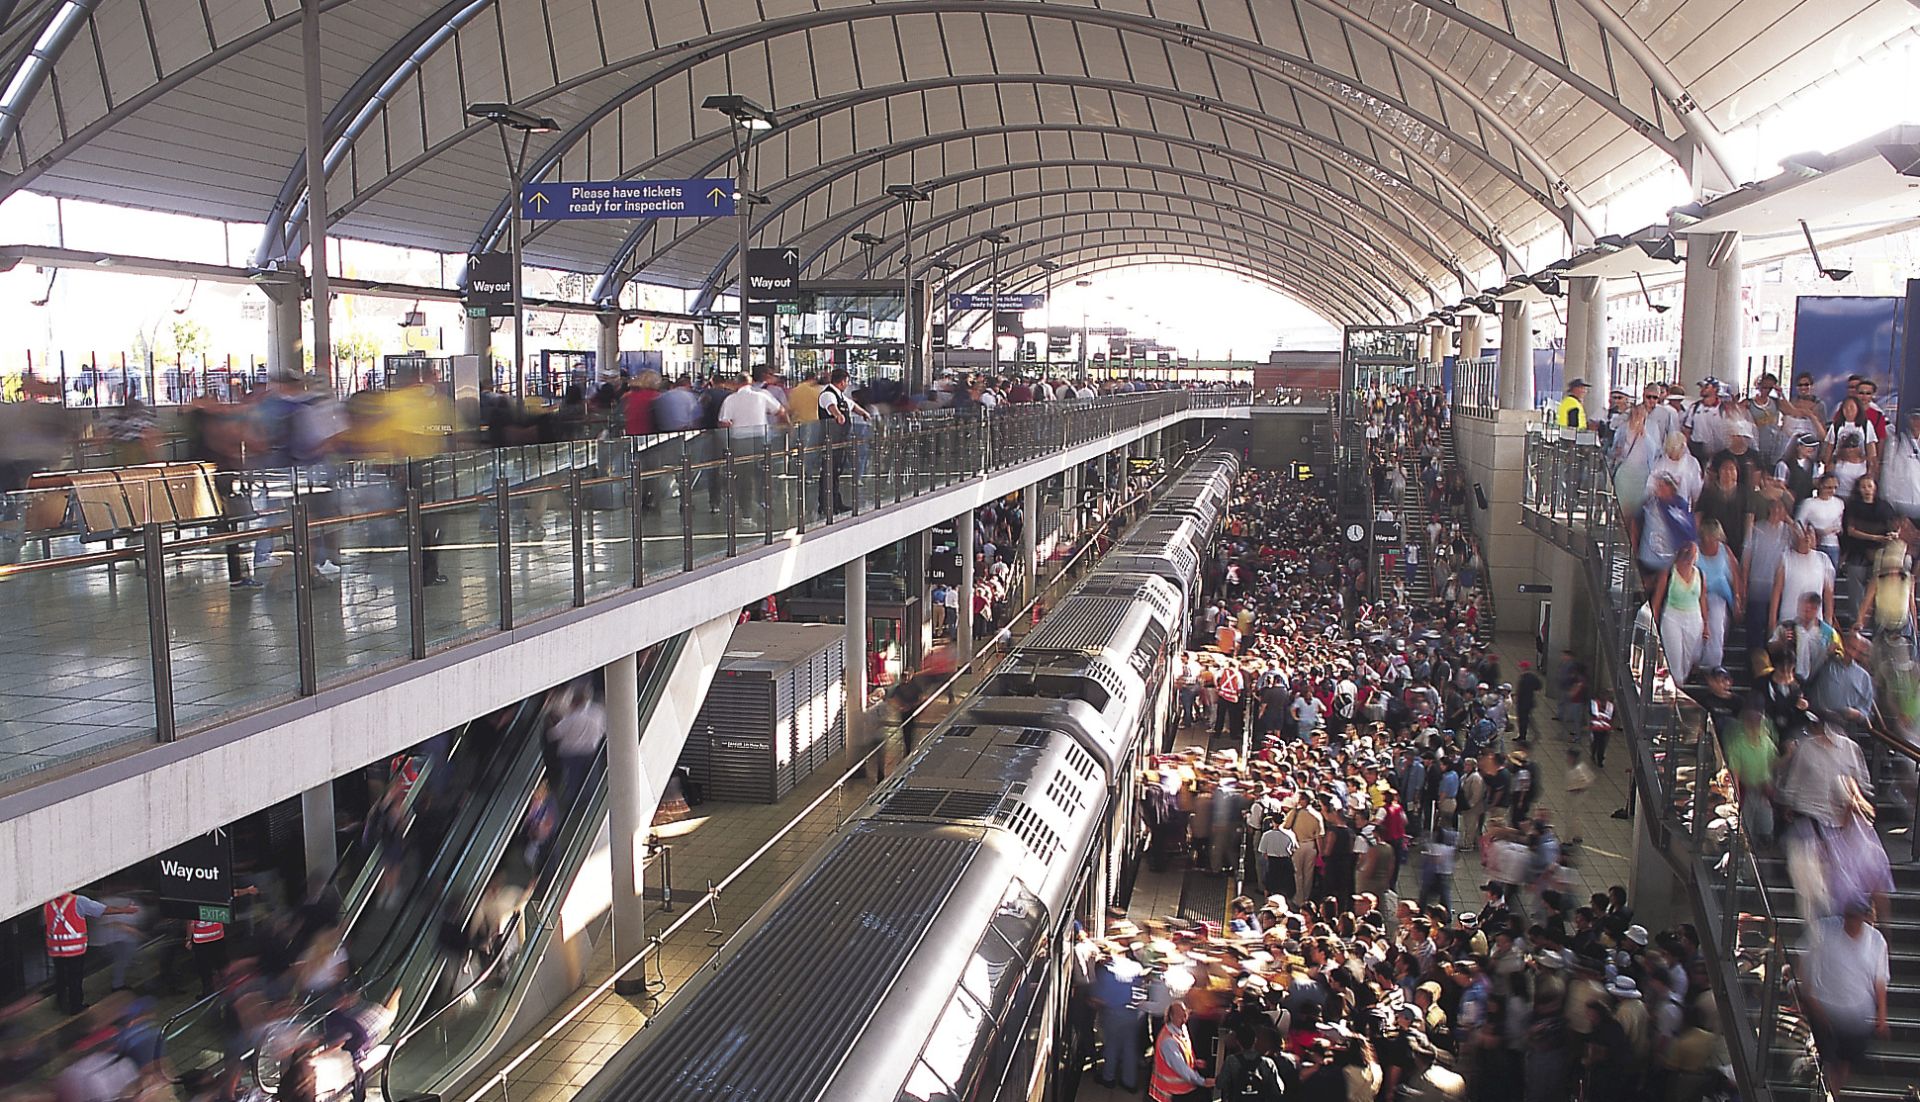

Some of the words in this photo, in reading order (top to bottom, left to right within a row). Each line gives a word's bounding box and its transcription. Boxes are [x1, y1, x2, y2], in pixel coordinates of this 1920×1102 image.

[572, 187, 610, 199] Please
[613, 186, 640, 198] have
[643, 186, 682, 197] tickets
[569, 202, 601, 214] ready
[604, 201, 621, 212] for
[624, 200, 685, 212] inspection
[473, 281, 494, 294] Way
[495, 282, 511, 291] out
[750, 276, 773, 290] Way
[774, 278, 791, 287] out
[160, 860, 194, 882] Way
[194, 867, 219, 880] out
[201, 908, 219, 920] EXIT
